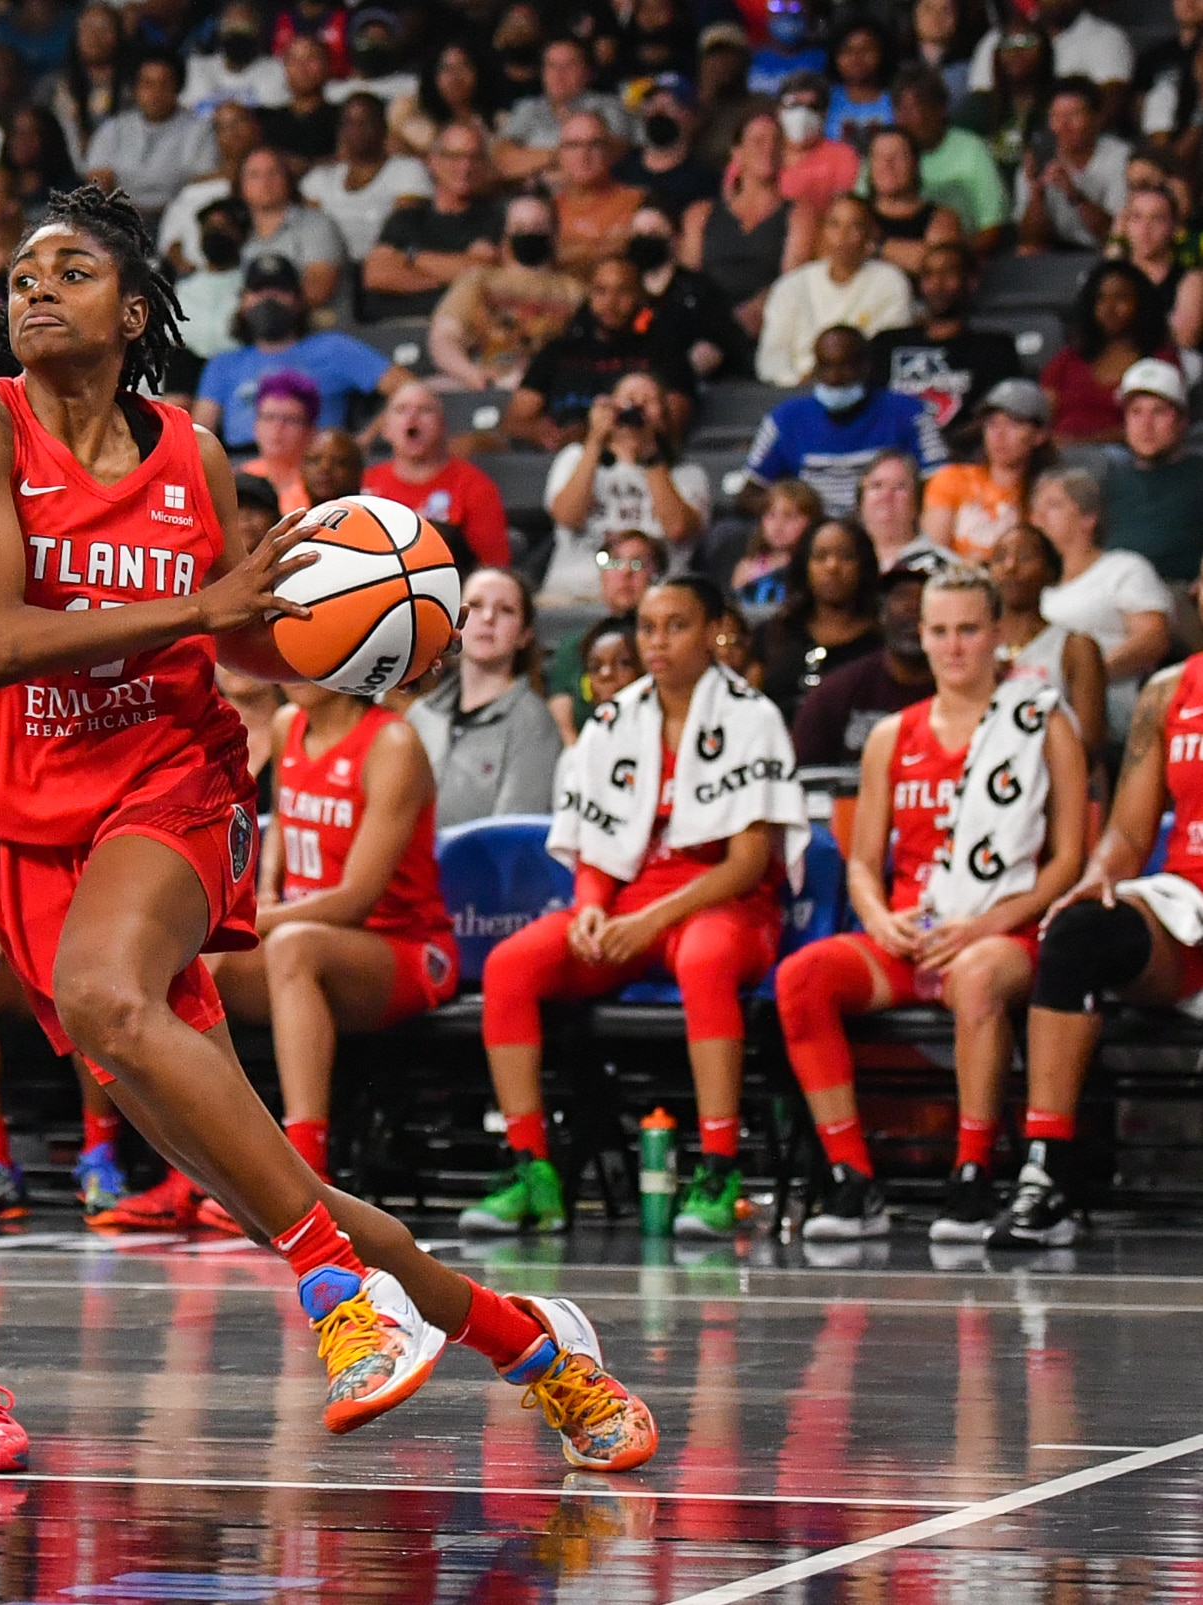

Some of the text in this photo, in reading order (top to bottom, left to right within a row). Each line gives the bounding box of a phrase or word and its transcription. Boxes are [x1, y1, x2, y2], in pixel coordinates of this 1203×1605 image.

[150, 509, 194, 528] Microsoft
[28, 535, 195, 597] TLANTA
[24, 675, 157, 720] EMORY
[25, 709, 157, 738] HEALTHCARE
[1169, 733, 1203, 763] AT
